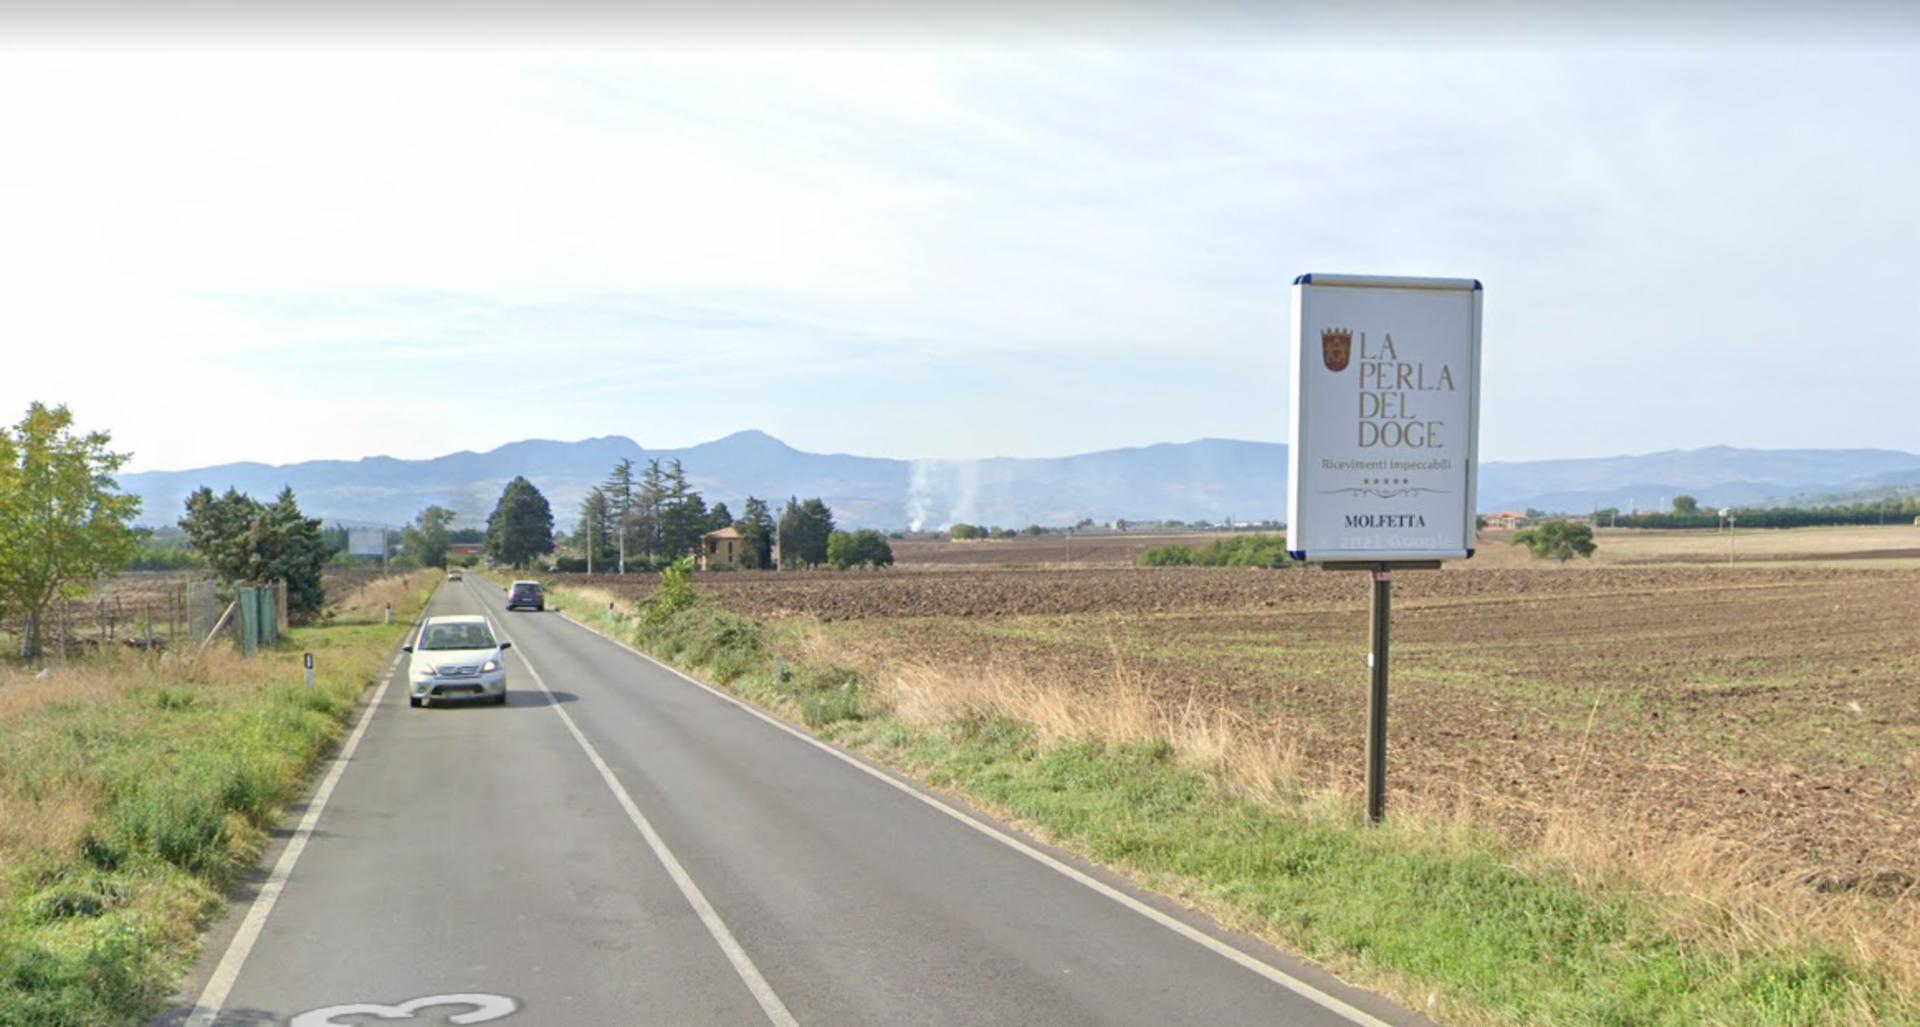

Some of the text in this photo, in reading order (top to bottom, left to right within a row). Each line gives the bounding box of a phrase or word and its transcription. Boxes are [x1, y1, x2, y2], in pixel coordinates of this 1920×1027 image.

[1360, 331, 1397, 361] LA
[1359, 362, 1455, 391] PERLA
[1359, 391, 1417, 419] DEL
[1358, 421, 1445, 449] DOGE
[1321, 458, 1452, 471] Ricevimenti impeccabili
[1344, 514, 1426, 529] MOLFETTA
